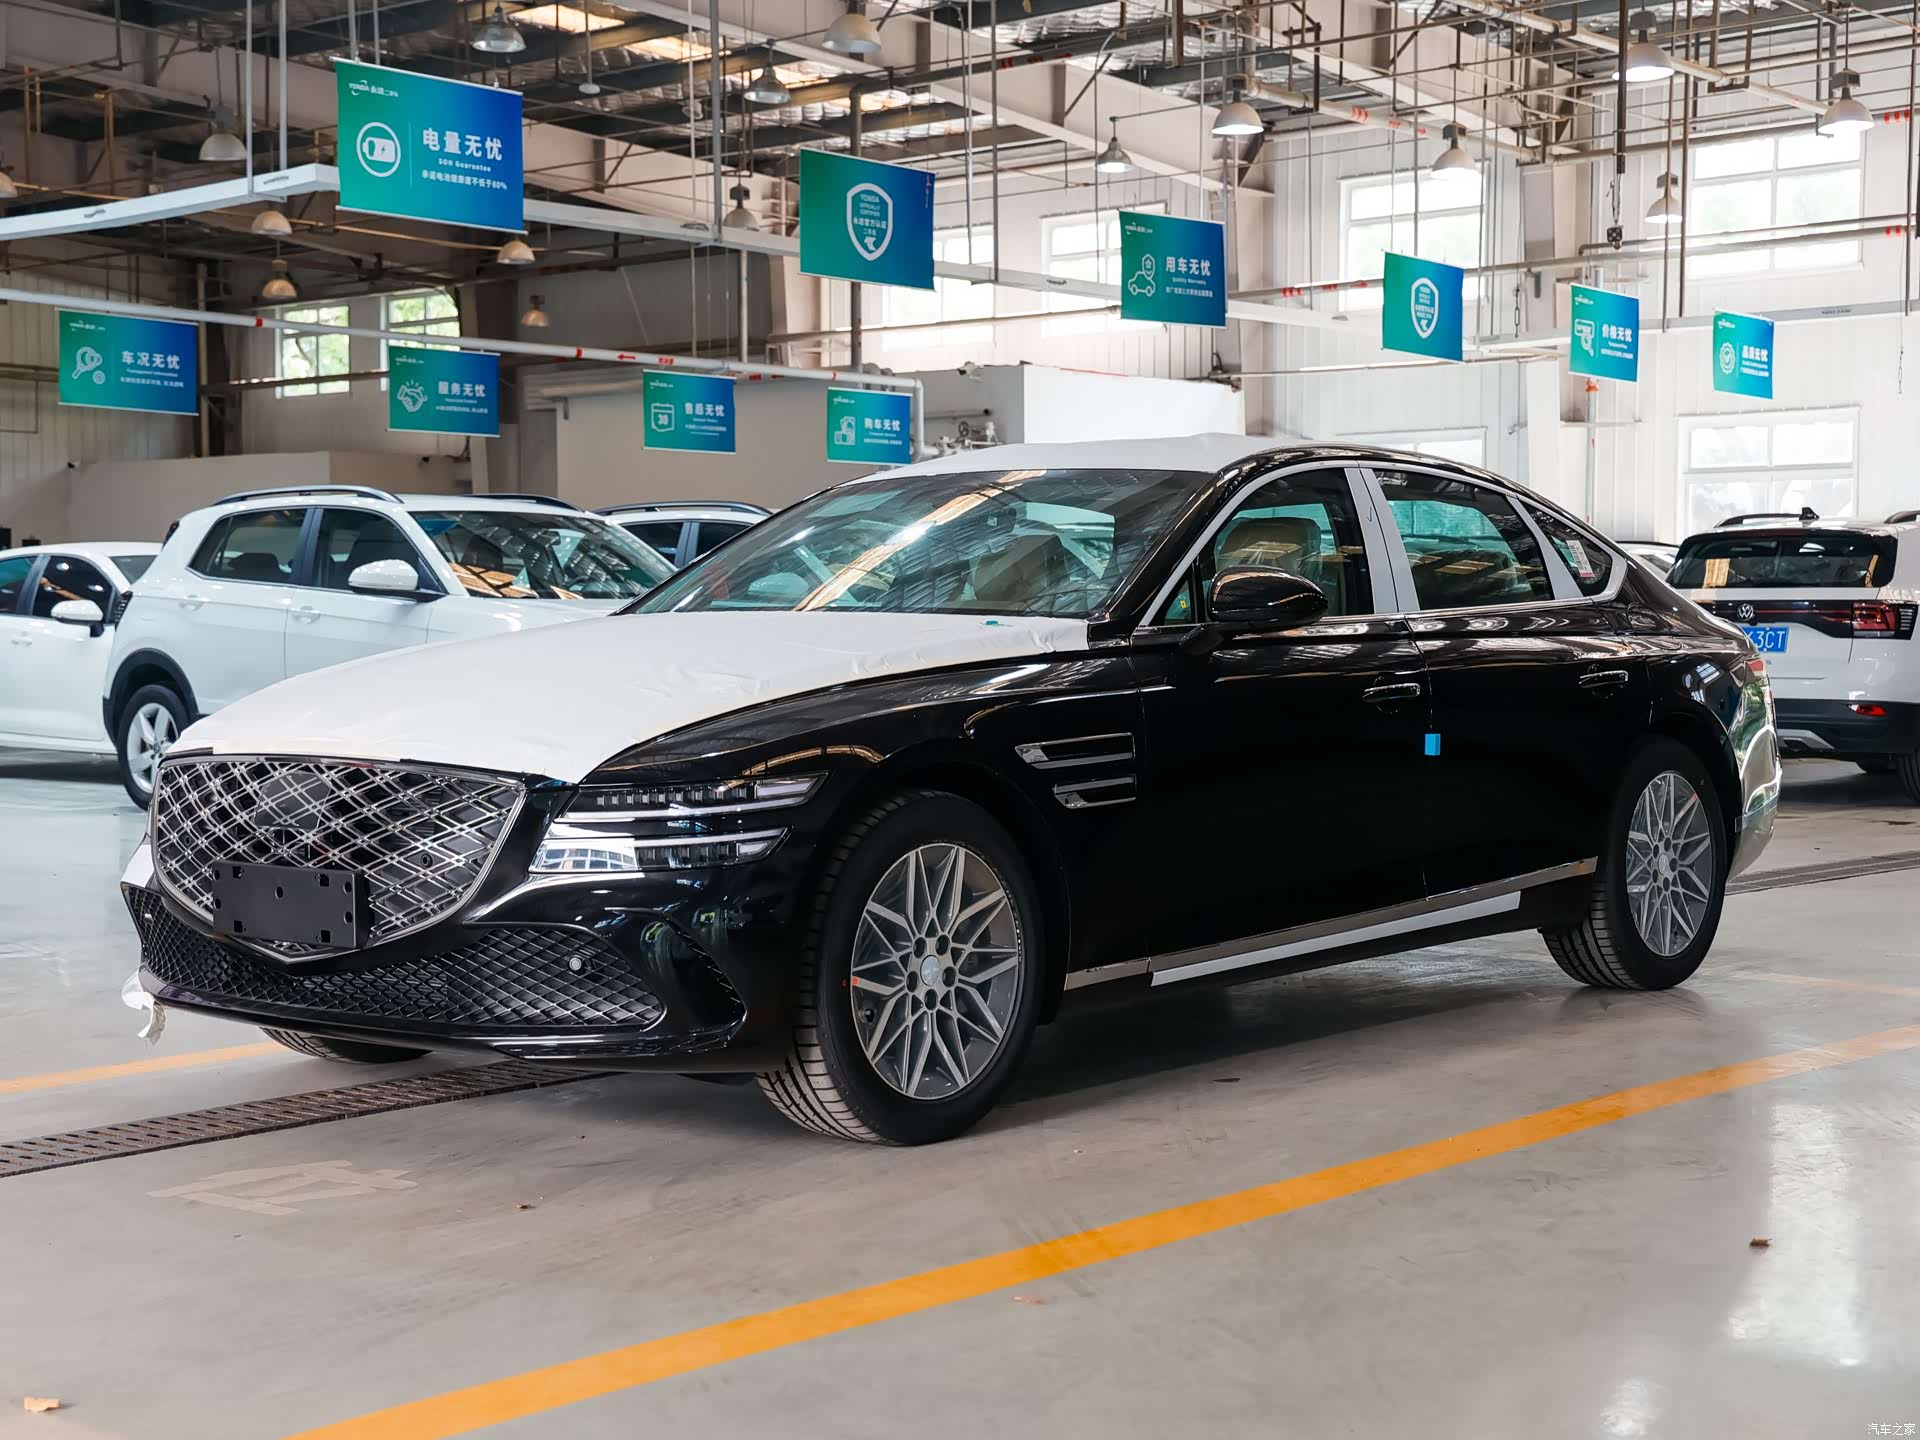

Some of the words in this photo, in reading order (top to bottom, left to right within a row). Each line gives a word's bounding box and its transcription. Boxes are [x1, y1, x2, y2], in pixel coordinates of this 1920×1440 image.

[422, 127, 503, 161] 电量无忧
[454, 160, 492, 173] Guarantee
[1165, 256, 1211, 277] 用车无忧
[121, 350, 180, 370] 车况无忧
[438, 381, 486, 397] 服务无忧
[684, 402, 725, 417] 售后无忧
[864, 417, 901, 432] 购车无忧
